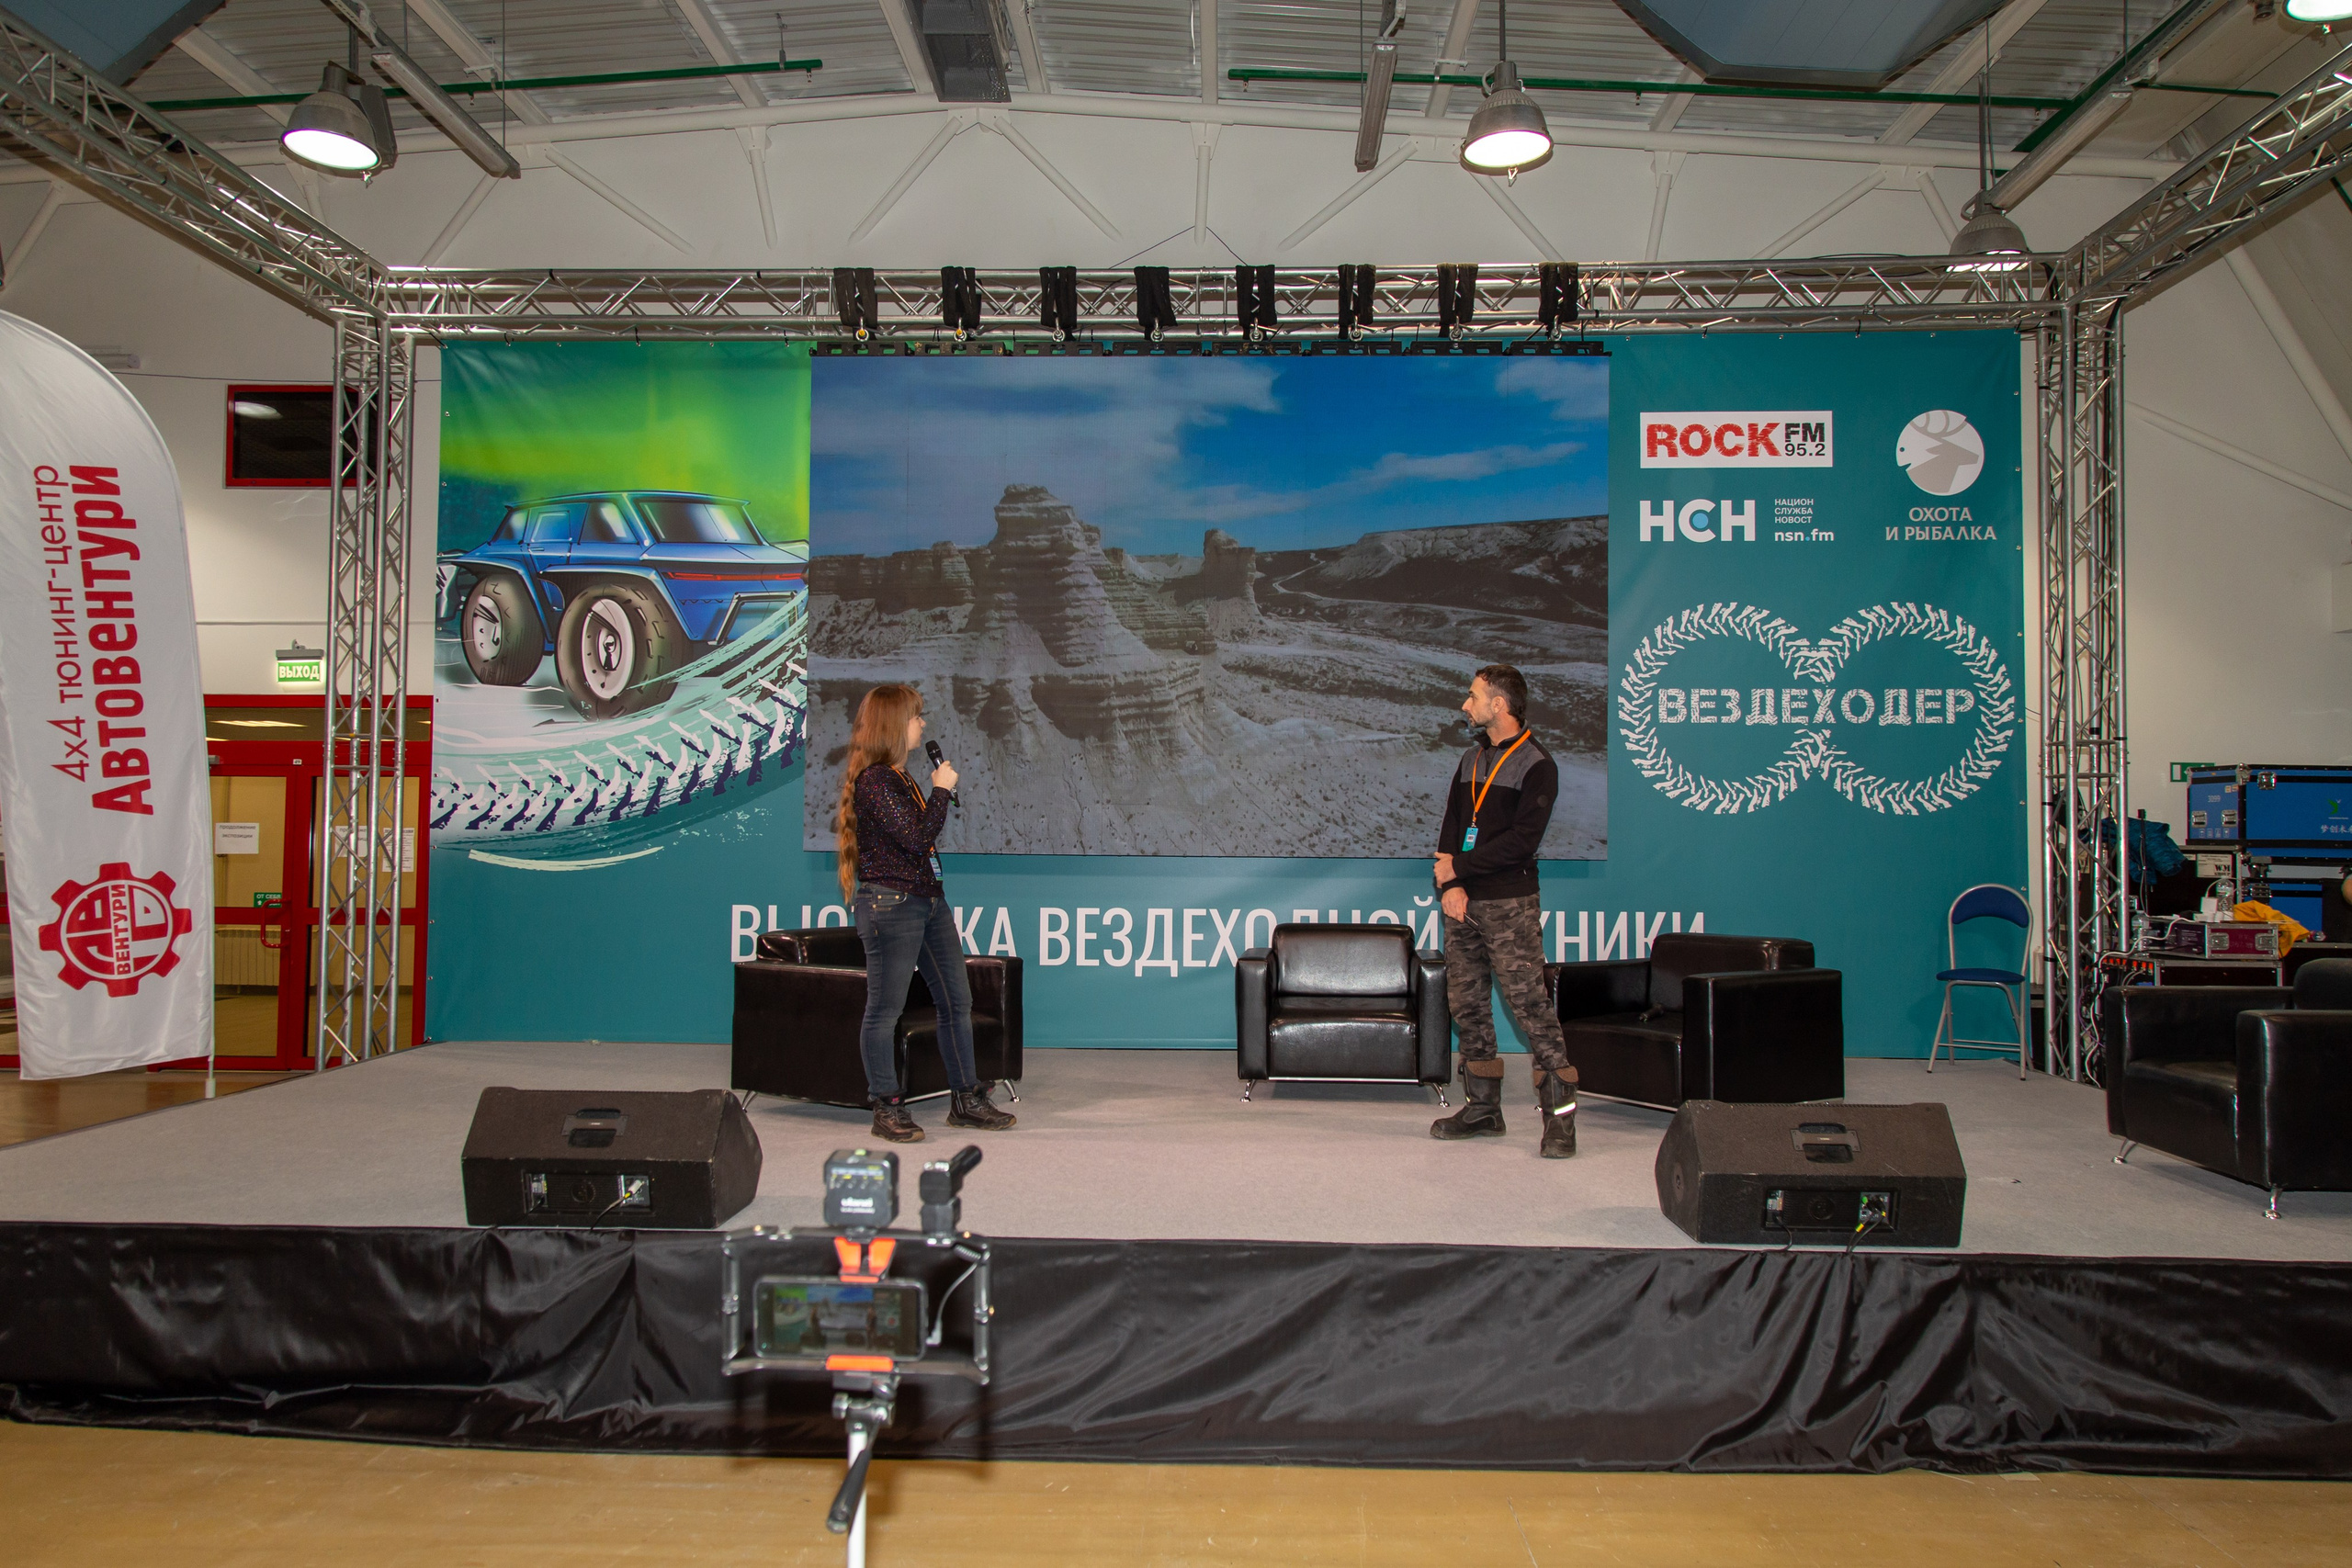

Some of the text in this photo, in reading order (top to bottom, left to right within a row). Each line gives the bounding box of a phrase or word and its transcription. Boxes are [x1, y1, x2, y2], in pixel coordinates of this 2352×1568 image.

[1645, 422, 1826, 458] ROCK FM
[1784, 443, 1826, 457] 95.2
[1774, 498, 1815, 506] НАЦИОН
[1774, 507, 1814, 515] СЛУЖБА
[1908, 506, 1973, 523] ОХОТА
[1639, 498, 1756, 543] НСН
[1774, 528, 1834, 542] nsn.fm
[1885, 526, 1996, 542] И РЫБАЛКА
[33, 465, 84, 704] тюнинг-центр
[278, 665, 320, 680] ВЫХОД
[1657, 688, 1974, 726] ВЕЗДЕХОДЕР
[110, 884, 132, 976] ВЕНТУРИ
[1039, 896, 1440, 977] ВЕЗДЕХОЙ
